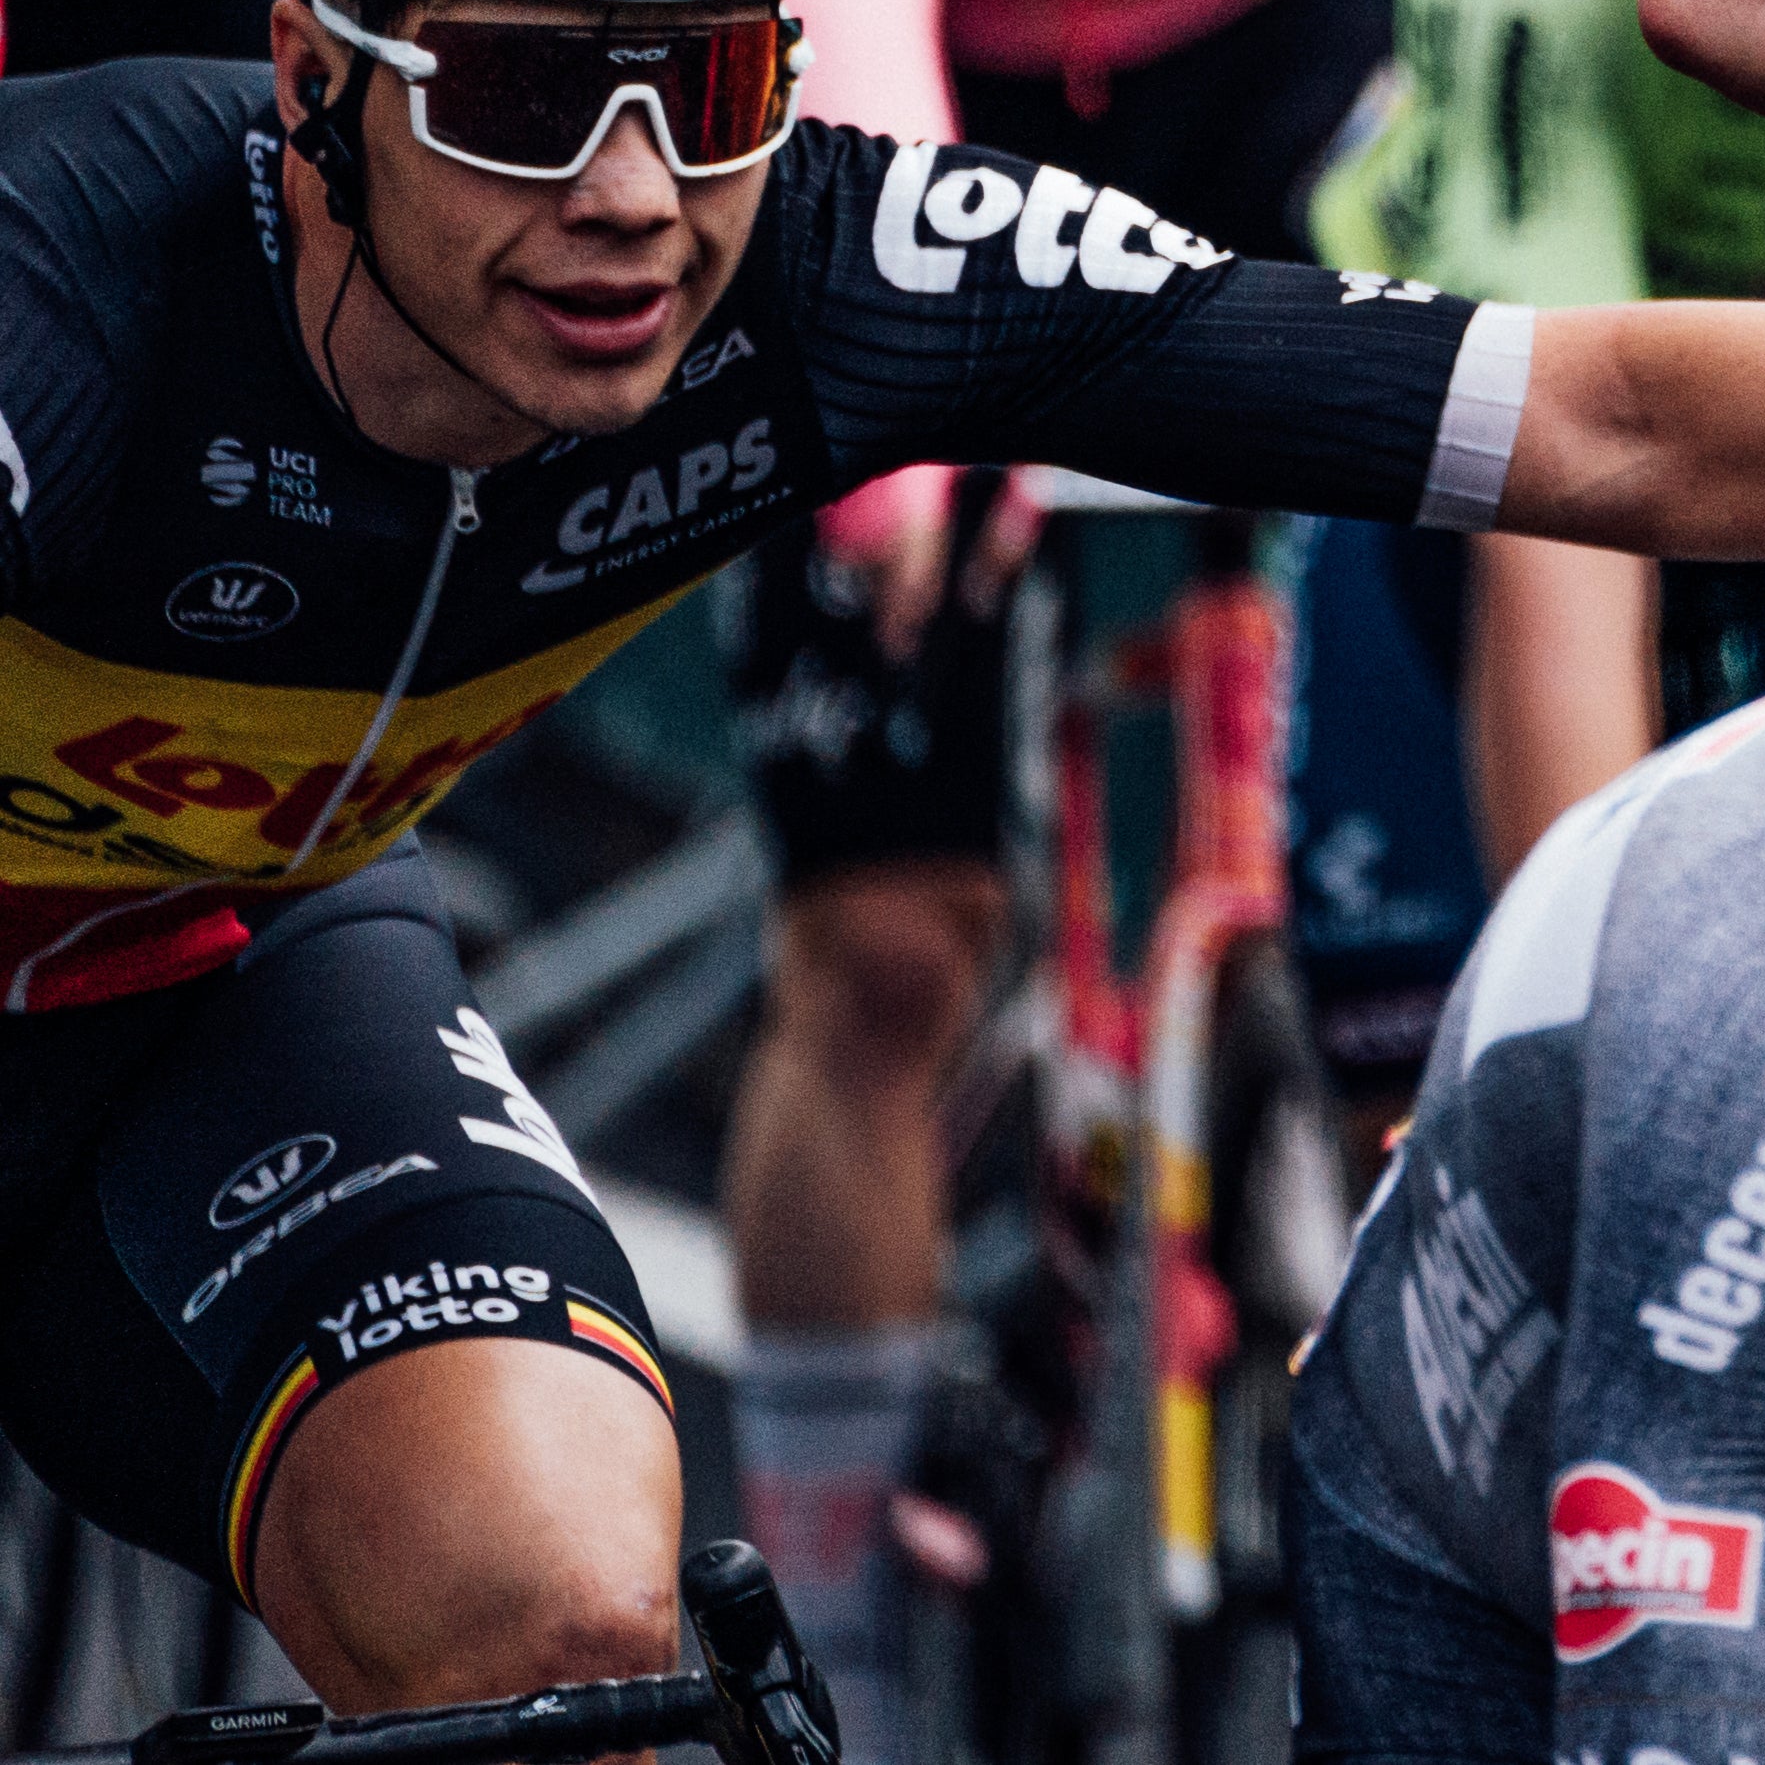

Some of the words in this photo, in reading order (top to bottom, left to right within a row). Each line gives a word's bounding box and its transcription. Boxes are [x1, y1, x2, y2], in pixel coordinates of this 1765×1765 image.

[269, 445, 317, 477] UCI
[268, 472, 318, 500] PRO
[557, 418, 777, 554] CAPS
[269, 495, 333, 528] TEAM
[211, 1711, 288, 1732] GARMIN
